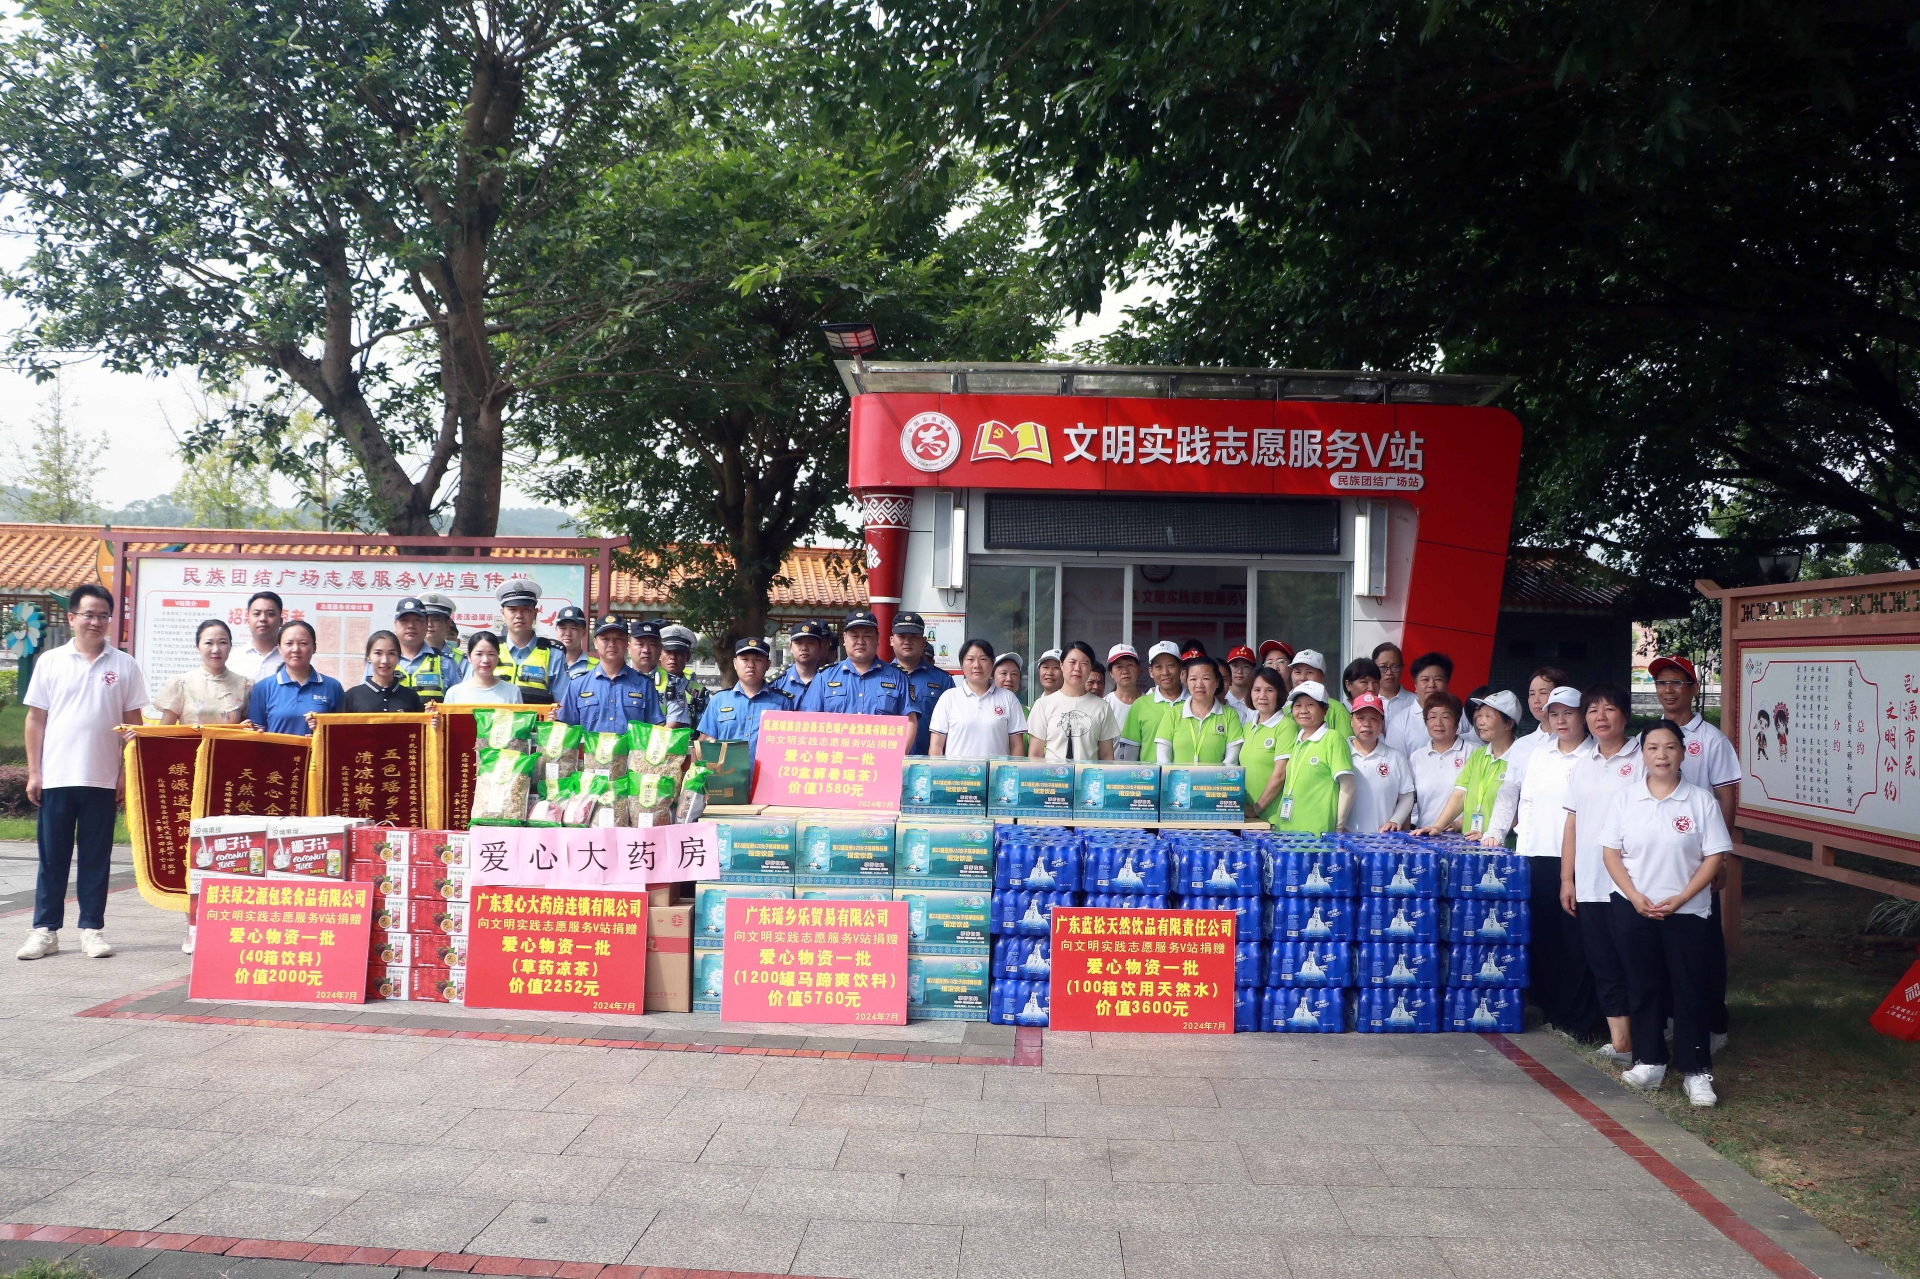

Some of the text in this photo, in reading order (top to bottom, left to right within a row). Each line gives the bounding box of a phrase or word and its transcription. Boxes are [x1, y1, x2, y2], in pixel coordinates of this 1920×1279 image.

[1063, 422, 1424, 471] 文明实践志愿服务V站
[1337, 475, 1420, 488] 民族团结广场站
[1903, 673, 1918, 777] 乳源市民
[765, 735, 898, 750] 向文明实践志愿服务V站捐赠
[1833, 719, 1841, 752] 分约
[1857, 719, 1865, 755] 总约
[784, 749, 875, 766] 爱心物资一批
[1884, 701, 1898, 802] 文明公约
[223, 780, 234, 816] 乳源瑶族自治
[788, 782, 864, 797] 价值1580元
[857, 801, 894, 809] 2024年7月
[213, 835, 253, 852] 椰子汁
[290, 837, 330, 854] 椰子汁
[215, 850, 249, 862] COCONUT
[292, 852, 327, 863] COCONUT
[479, 836, 708, 873] 爱心大药房
[216, 861, 236, 870] JUICE
[294, 862, 313, 872] JUICE
[206, 884, 367, 908] 韶关绿之源包装食品有限公司
[476, 892, 642, 918] 广东爱心大药房连锁有限公司
[206, 909, 362, 925] 向文明实践志愿服务V站捐赠
[744, 905, 889, 928] 广东瑶乡乐贸易有限公司
[477, 917, 637, 935] 向文明实践志愿服务V站捐赠
[1055, 915, 1232, 937] 广东蓝松天然饮品有限责任公司
[229, 927, 335, 946] 爱心物资一批
[501, 935, 611, 956] 爱心物资一批
[733, 930, 899, 945] 向文明实践志愿服务V站捐赠
[1060, 939, 1226, 955] 向文明实践志愿服务V站捐赠
[759, 948, 872, 967] 爱心物资一批
[1086, 957, 1199, 976] 爱心物资一批
[234, 968, 323, 986] 价值2000元
[315, 991, 358, 1000] 2024年7月
[508, 977, 600, 996] 价值2252元
[592, 1001, 636, 1012] 2024年7月
[767, 990, 862, 1008] 价值5760元
[1095, 999, 1189, 1017] 价值3600元
[855, 1012, 899, 1022] 2024年7月
[1182, 1021, 1226, 1031] 2024年7月
